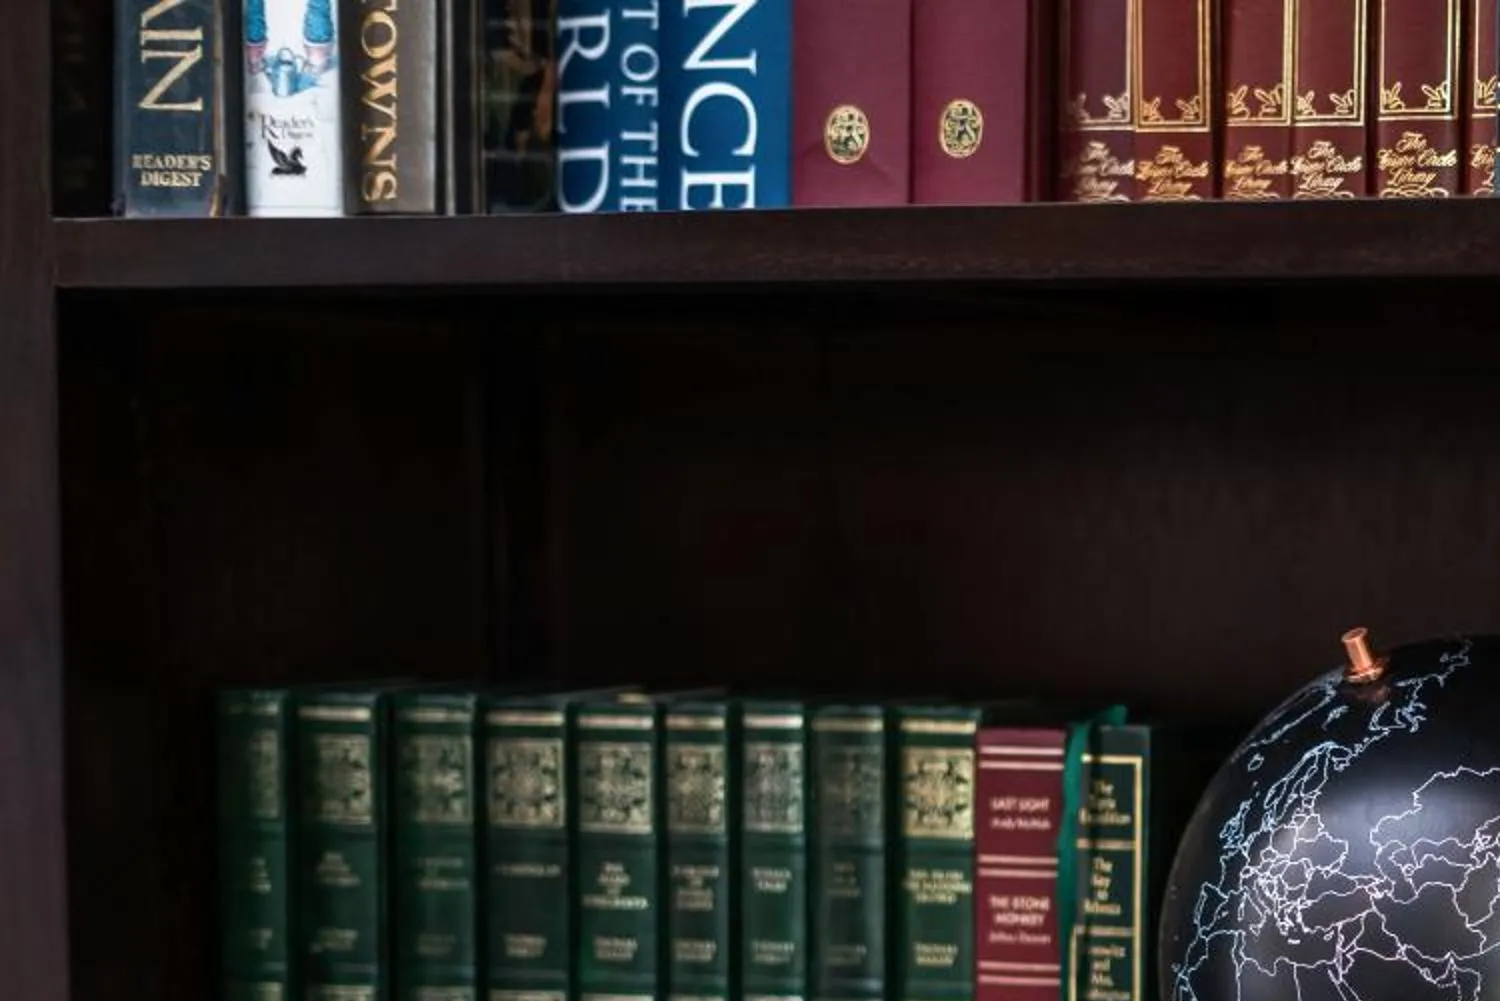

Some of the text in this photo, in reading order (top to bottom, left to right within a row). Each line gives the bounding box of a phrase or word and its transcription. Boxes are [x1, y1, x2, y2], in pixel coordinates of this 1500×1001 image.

[139, 0, 204, 112] IN
[361, 0, 399, 203] OWNS
[620, 43, 660, 107] OF
[680, 0, 758, 211] NCE
[131, 154, 213, 173] READER'S
[140, 171, 203, 188] DIGEST
[619, 120, 659, 213] THE
